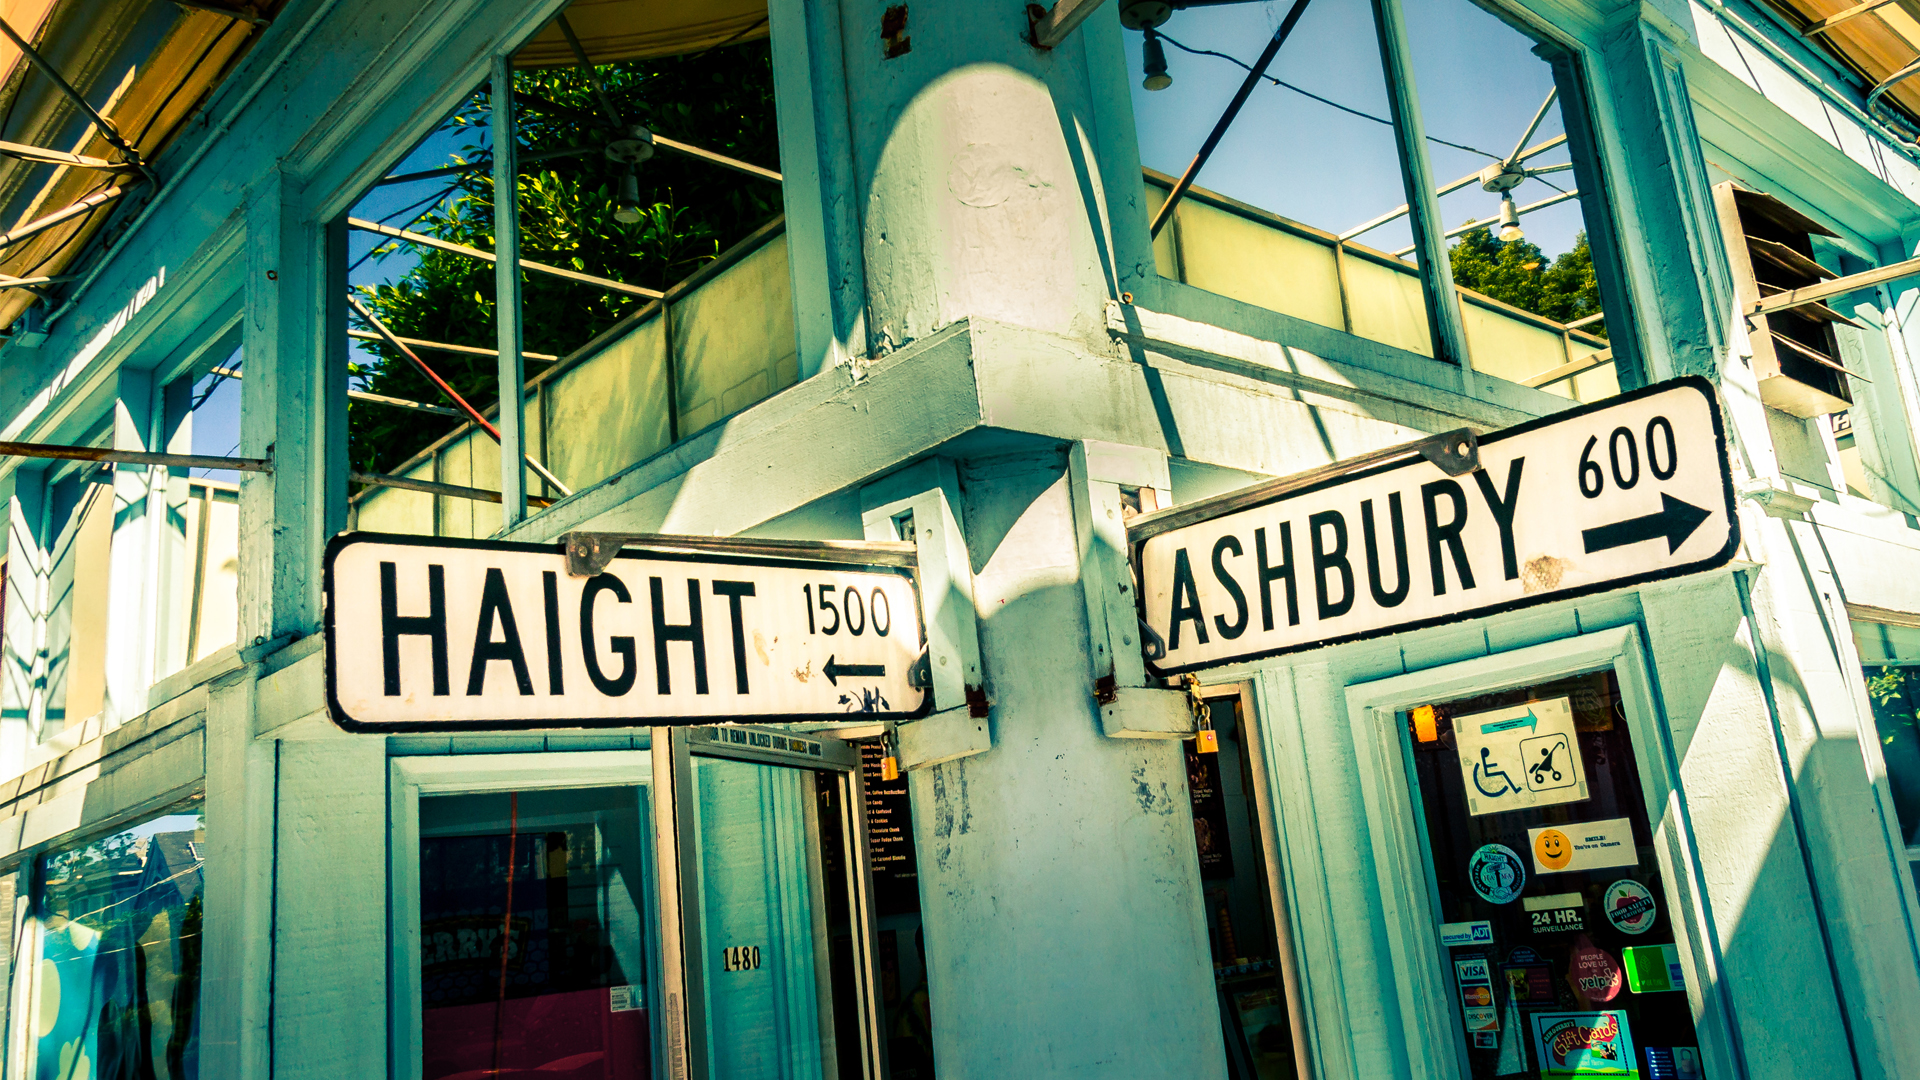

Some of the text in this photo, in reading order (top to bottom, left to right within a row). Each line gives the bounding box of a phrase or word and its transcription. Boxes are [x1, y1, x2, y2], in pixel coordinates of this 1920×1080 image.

[1578, 415, 1678, 499] 600
[1168, 456, 1525, 651] ASHBURY
[804, 583, 891, 637] 1500
[380, 561, 755, 698] HAIGHT
[1532, 910, 1582, 926] 24 HR.
[1610, 898, 1650, 918] FOOD SAFETY
[1473, 927, 1489, 938] ADT
[1533, 923, 1584, 934] SURVEILLANCE
[422, 923, 520, 966] ERRY'S
[723, 946, 760, 972] 1480
[1460, 965, 1486, 977] VISA
[1579, 974, 1606, 991] yelp
[1554, 1022, 1618, 1056] Gift Cards
